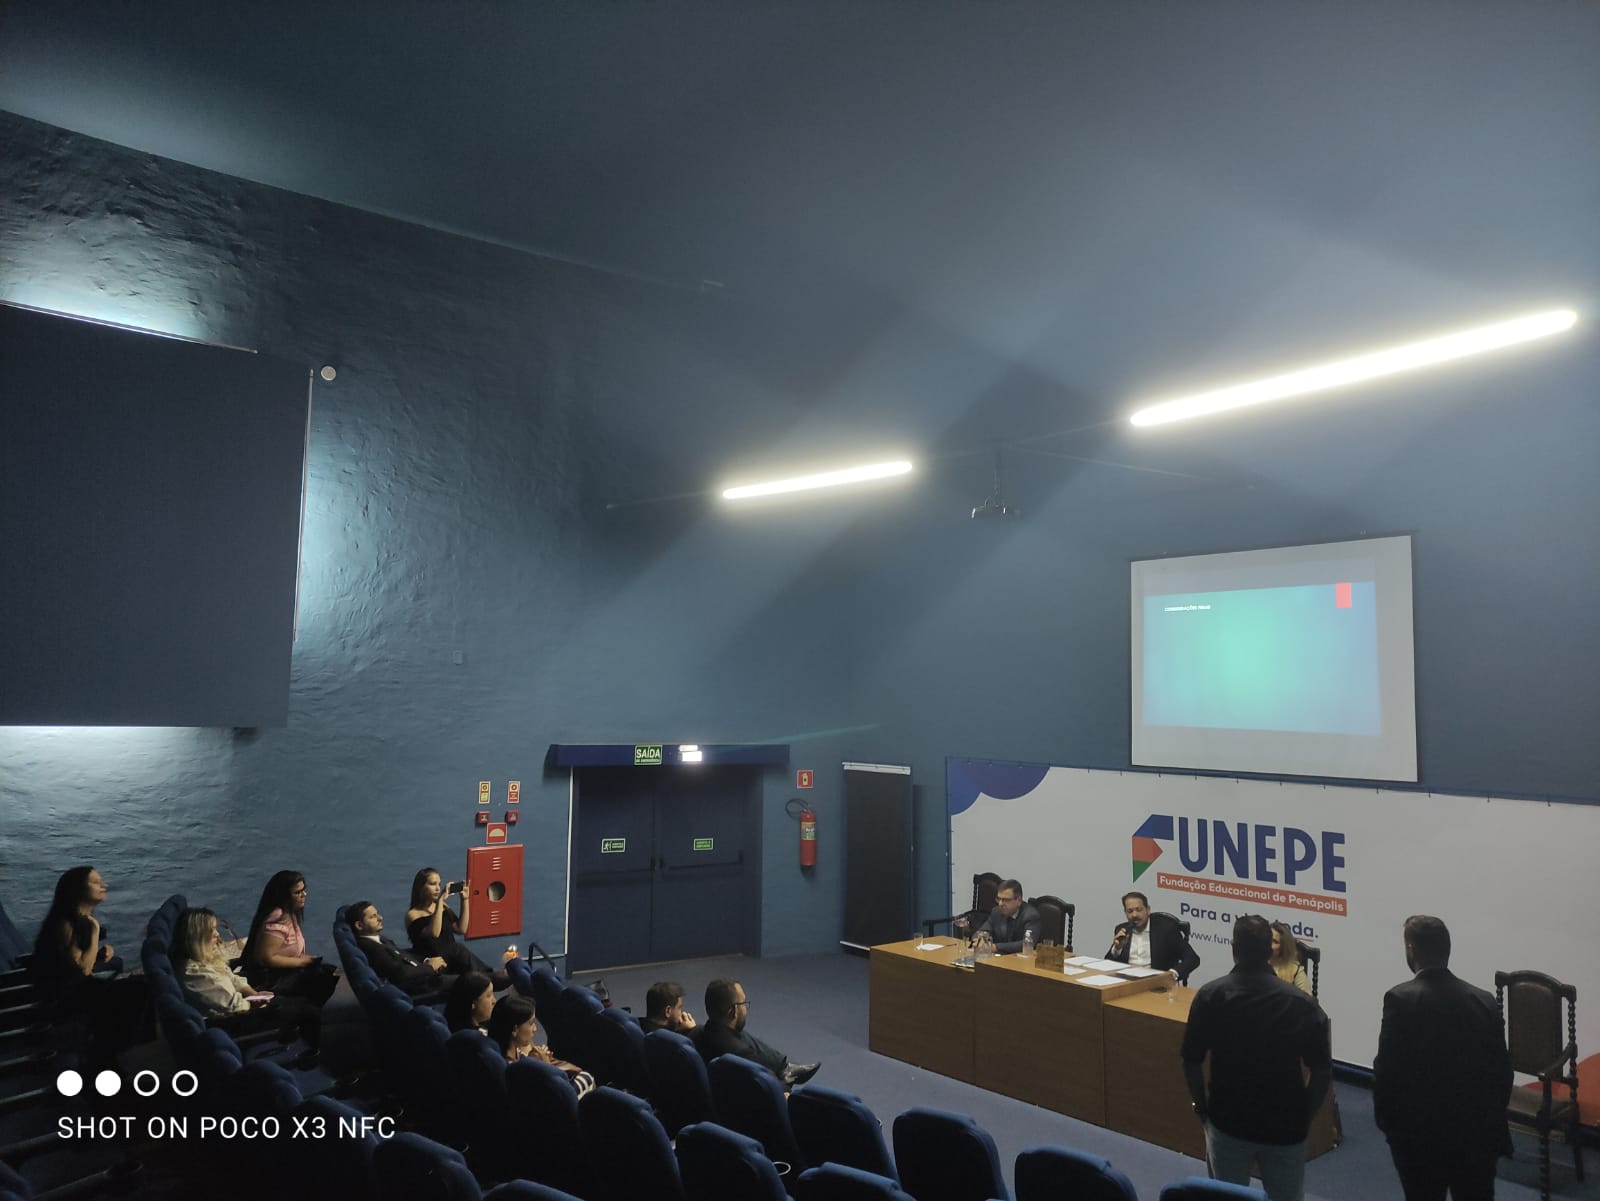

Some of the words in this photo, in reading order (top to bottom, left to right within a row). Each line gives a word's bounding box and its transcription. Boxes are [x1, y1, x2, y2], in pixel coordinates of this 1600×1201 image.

[636, 747, 660, 759] SAÍDA
[1159, 875, 1207, 891] Fundação
[1209, 882, 1270, 900] Educacional
[1272, 893, 1286, 903] de
[1288, 894, 1345, 912] Penápolis
[1180, 902, 1217, 921] Para
[1221, 912, 1231, 923] a
